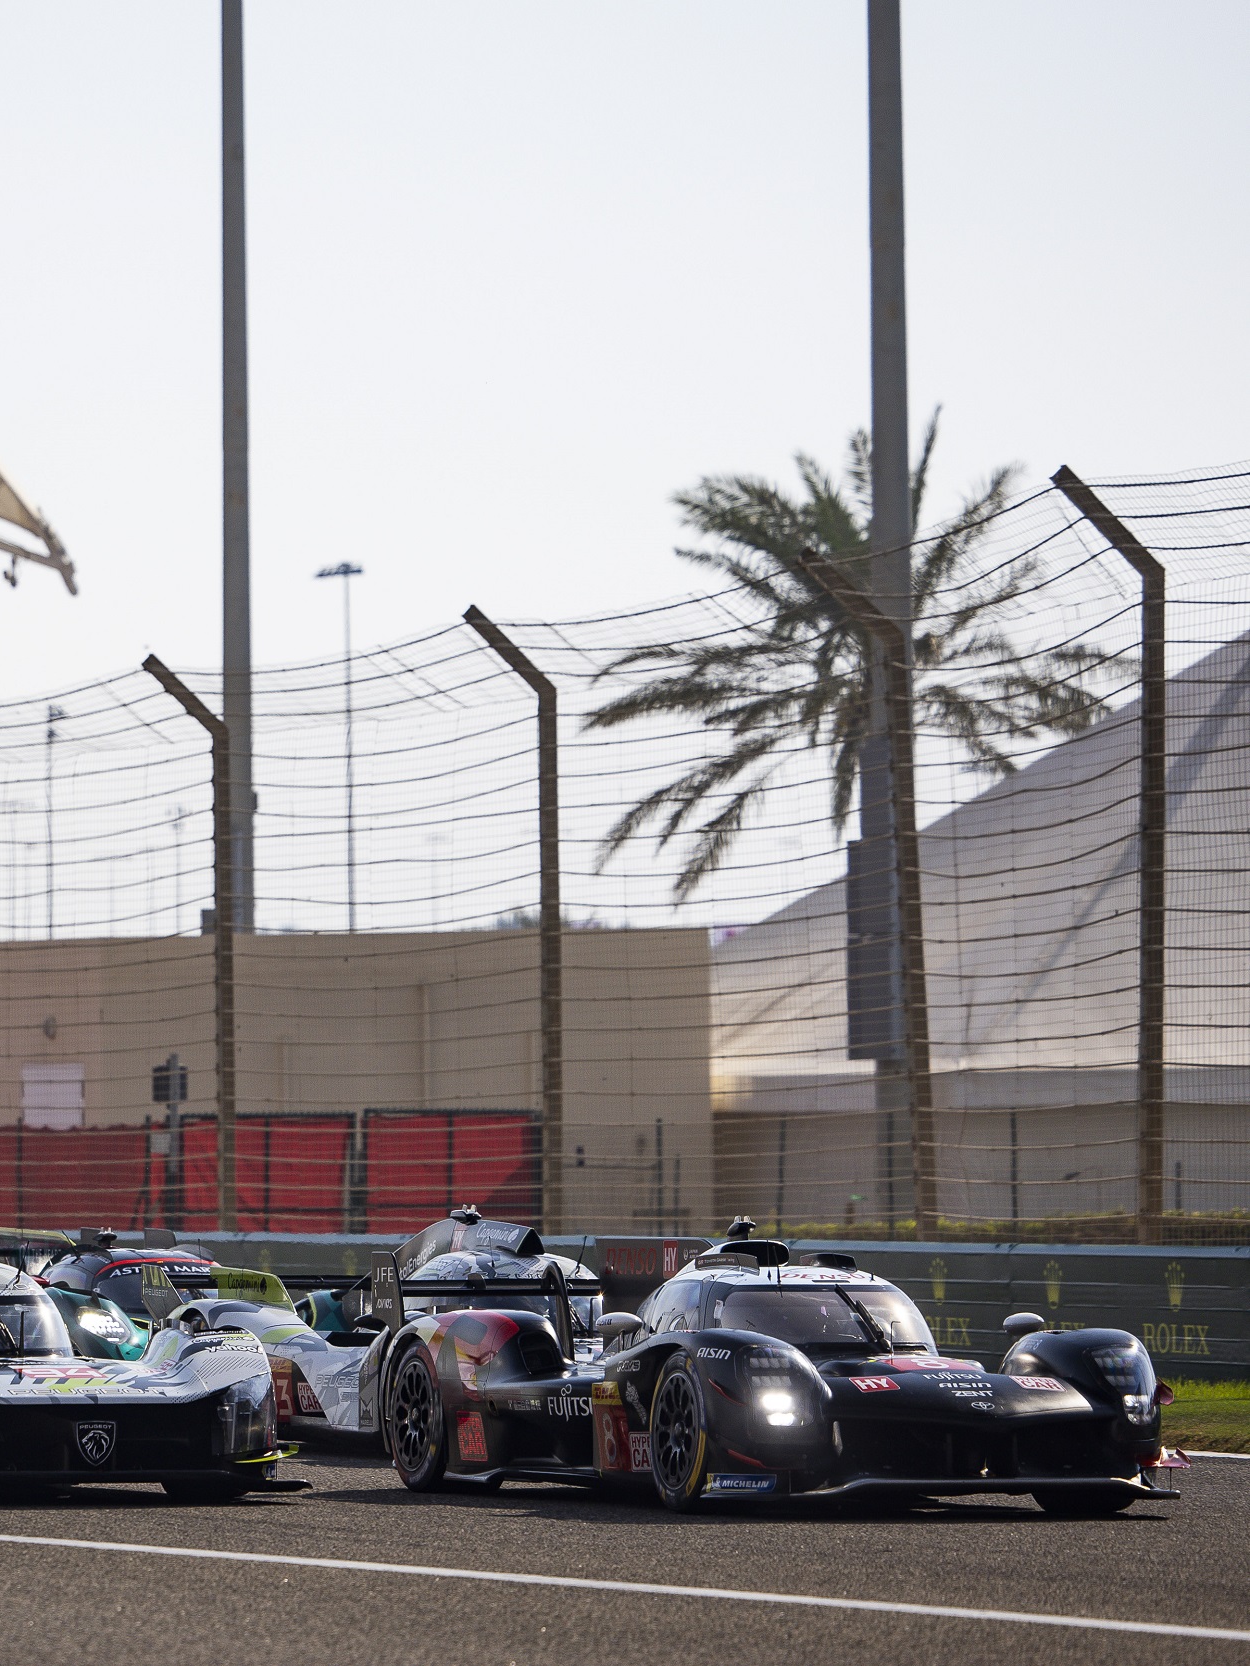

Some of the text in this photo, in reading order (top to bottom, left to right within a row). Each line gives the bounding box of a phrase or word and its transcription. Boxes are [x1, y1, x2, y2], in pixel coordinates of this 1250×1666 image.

[476, 1222, 512, 1245] Capgemini
[399, 1239, 437, 1281] talEnergies
[605, 1248, 657, 1275] DENSO
[664, 1248, 677, 1272] HY
[110, 1265, 210, 1279] ASTN MAR
[374, 1266, 394, 1283] JFE
[144, 1287, 168, 1298] PEUGEOT
[924, 1316, 971, 1346] OLEX
[1142, 1323, 1210, 1355] ROLEX
[697, 1347, 731, 1360] AISIN
[911, 1358, 950, 1369] 8
[298, 1385, 314, 1395] HYPE
[314, 1375, 359, 1389] PEUGEO
[857, 1378, 889, 1390] HY
[276, 1380, 293, 1416] 3
[602, 1413, 617, 1463] 8
[632, 1448, 650, 1468] CA
[721, 1480, 769, 1489] MICHELIN
